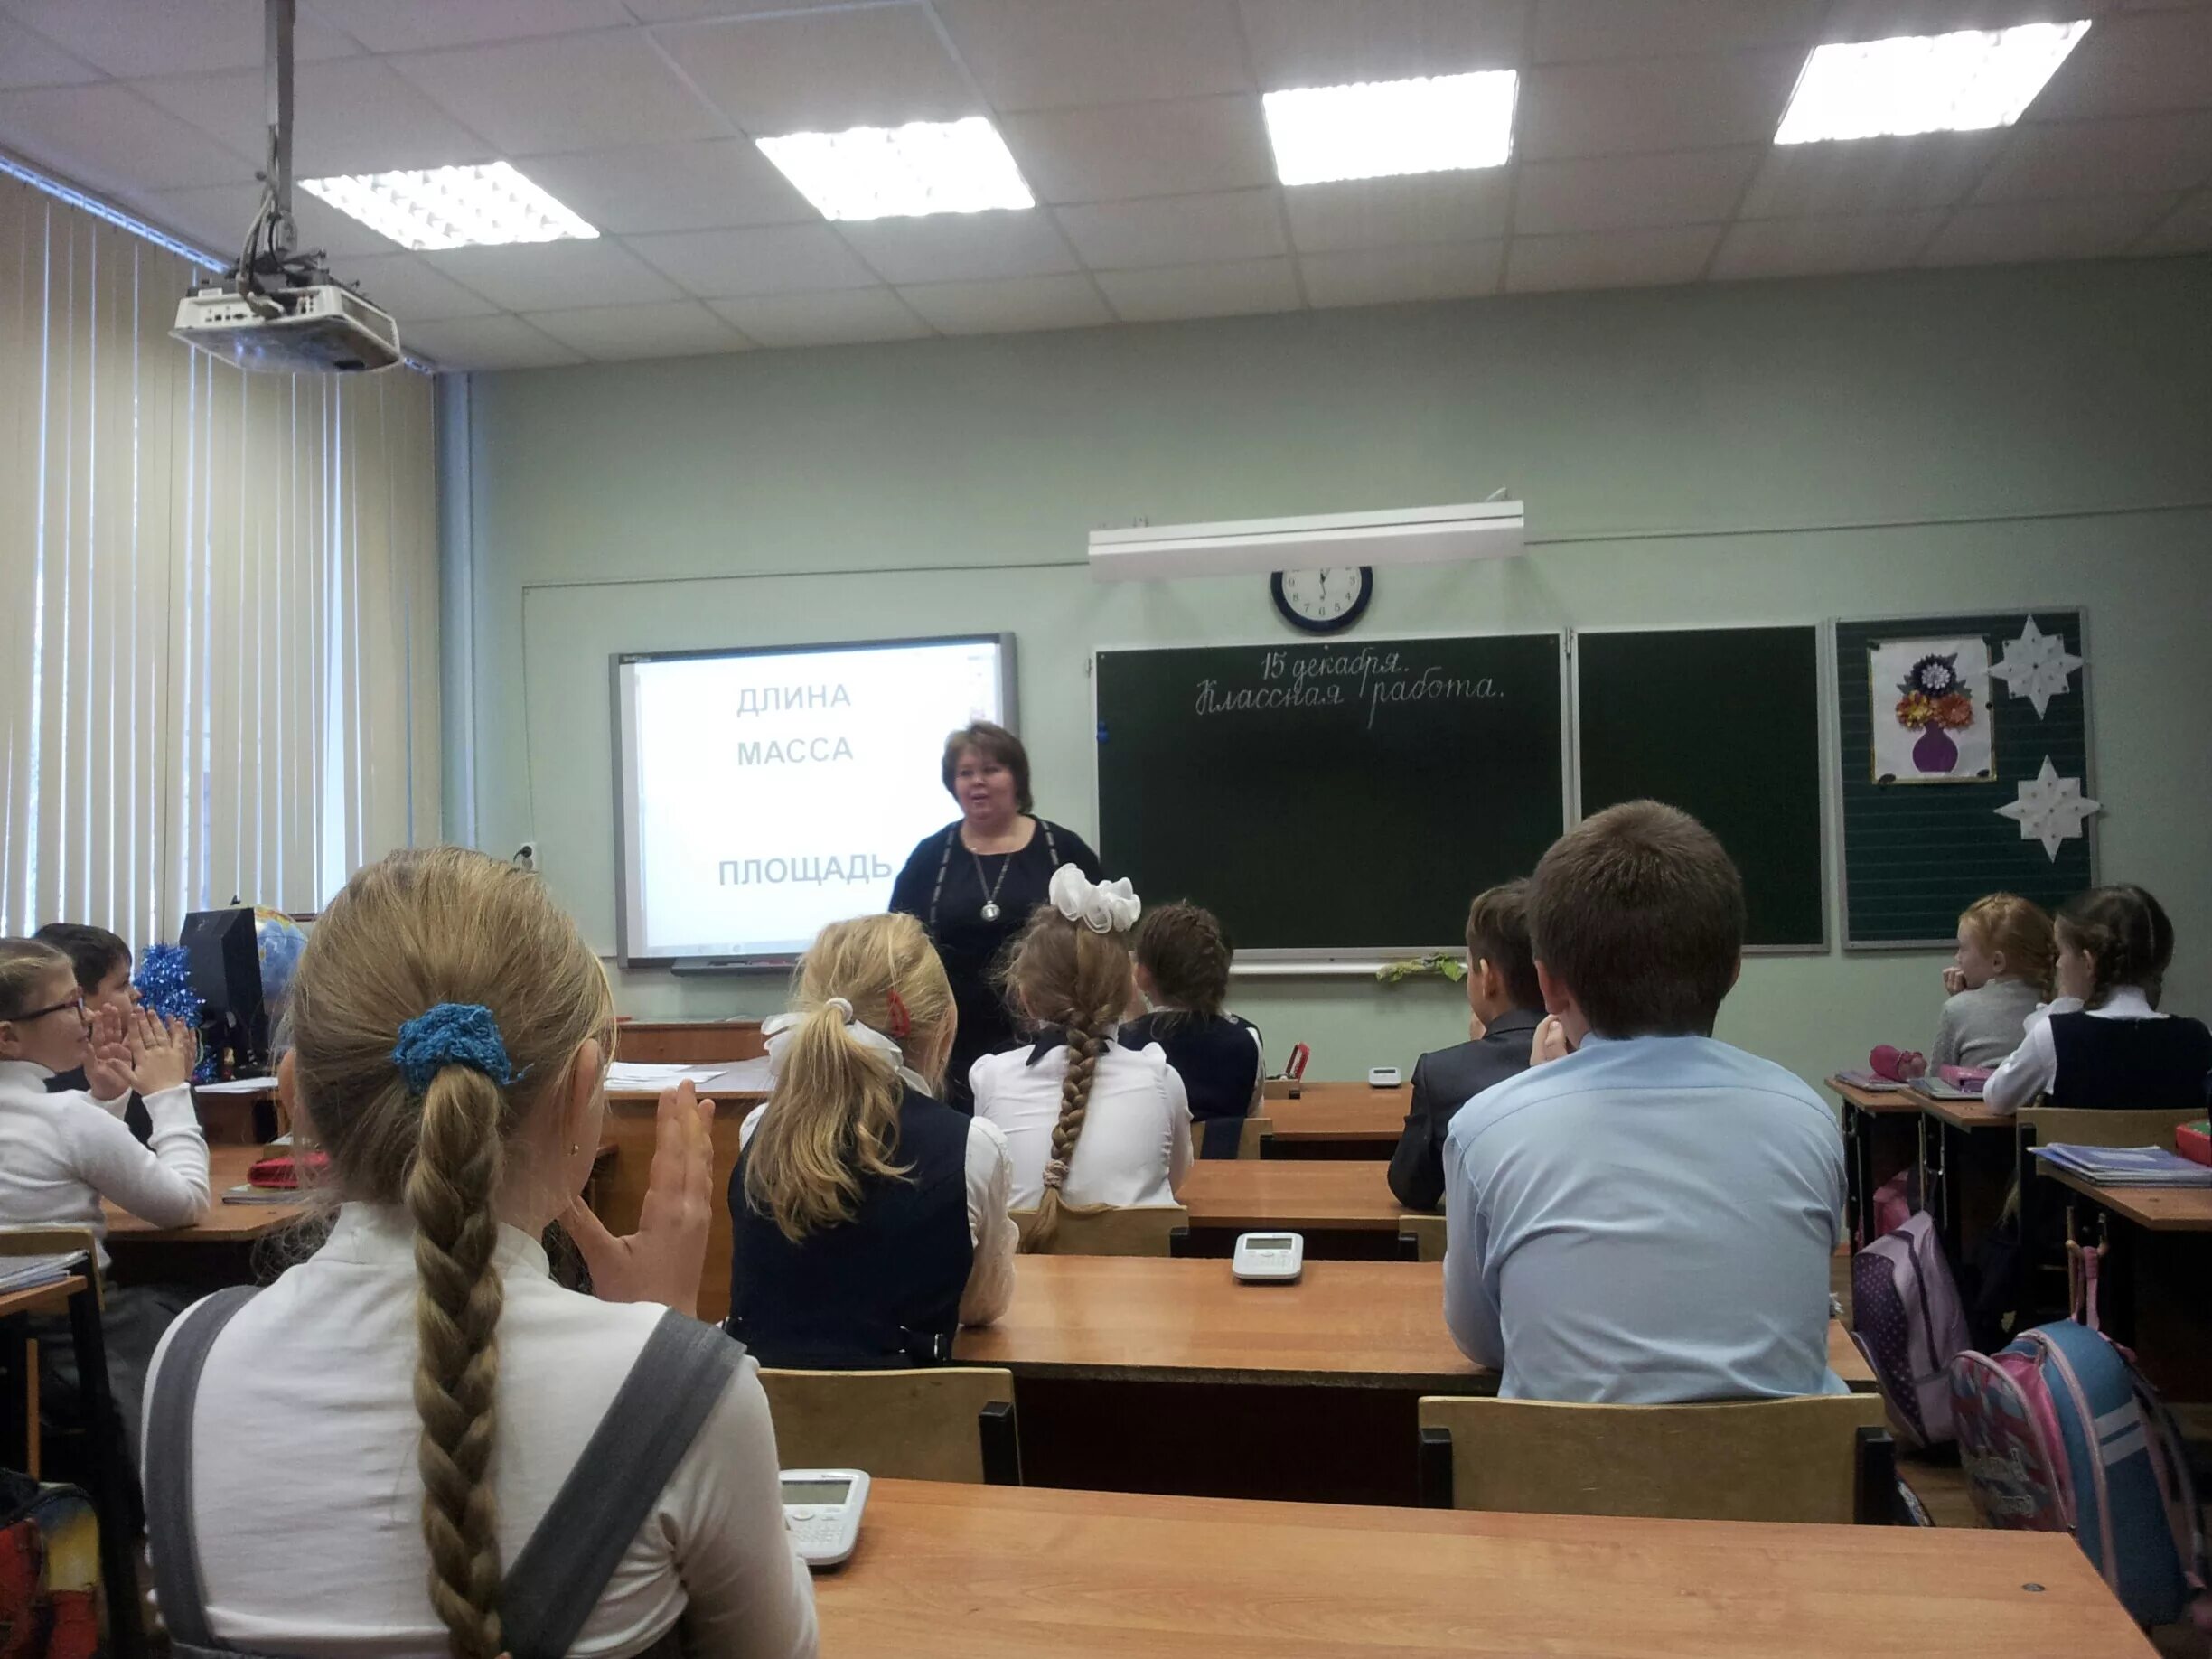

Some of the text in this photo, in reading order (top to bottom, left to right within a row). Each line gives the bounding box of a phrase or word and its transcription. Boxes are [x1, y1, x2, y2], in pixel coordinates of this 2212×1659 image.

[1304, 603, 1310, 613] 7
[1261, 651, 1288, 680] 15
[736, 684, 851, 717] ДЛИНА
[1195, 666, 1504, 730] Классная работа.
[736, 737, 854, 766] МАССА
[718, 854, 893, 886] ПЛОЩАДЬ
